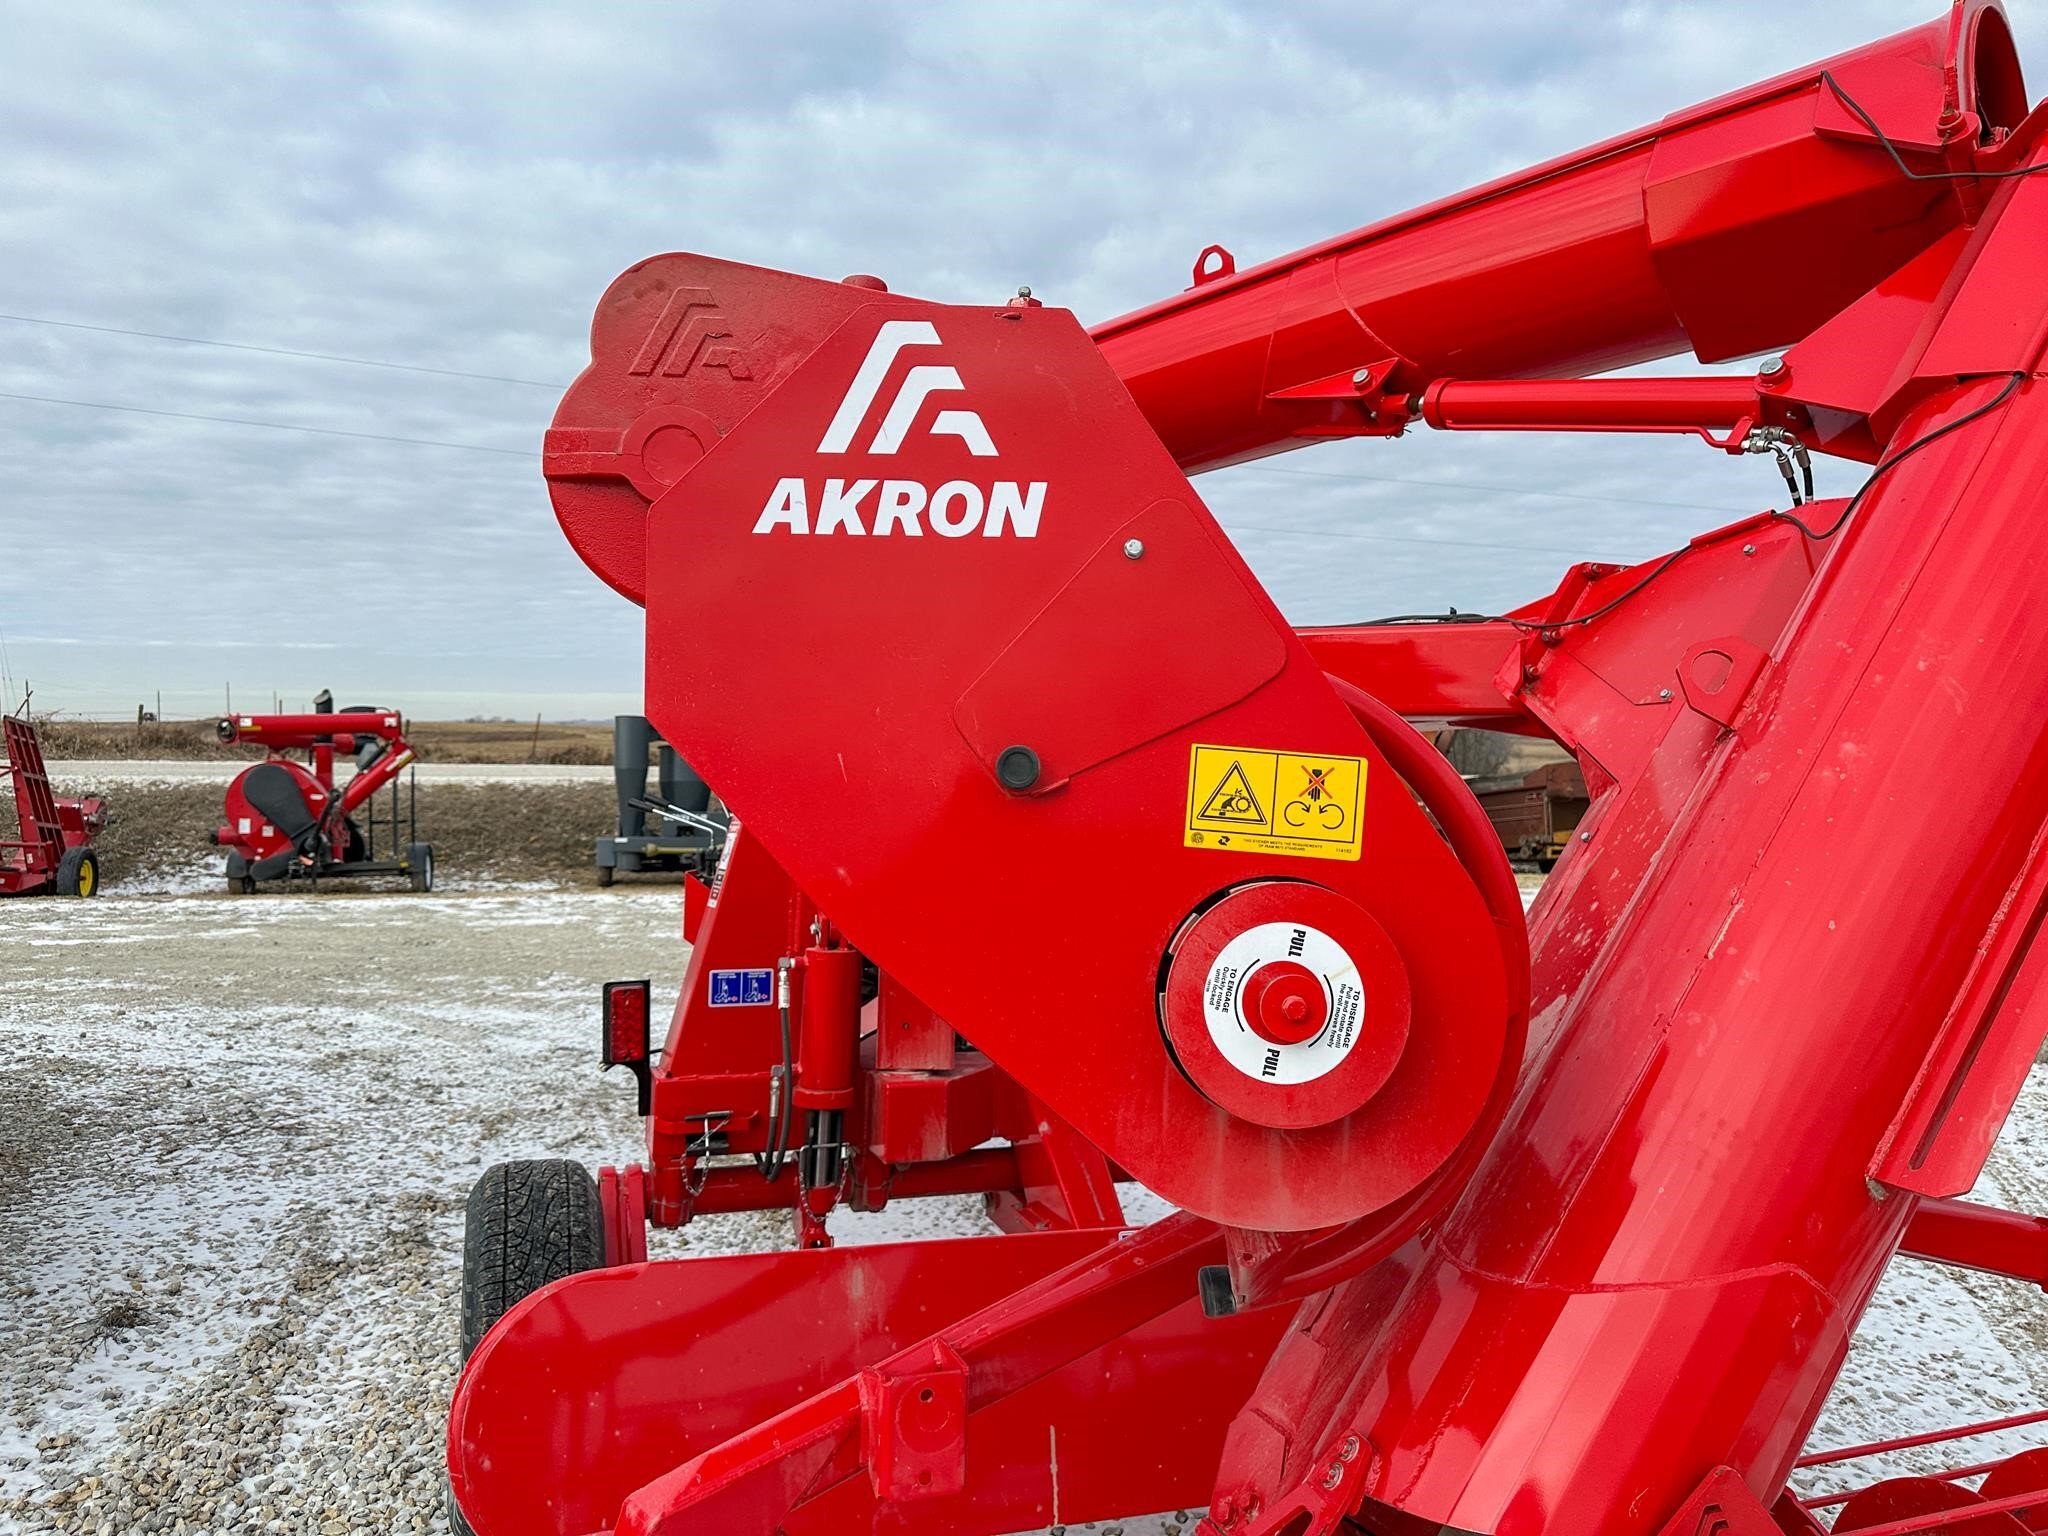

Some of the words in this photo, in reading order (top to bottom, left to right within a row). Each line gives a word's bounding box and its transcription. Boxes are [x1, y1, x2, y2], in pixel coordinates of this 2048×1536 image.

[752, 478, 1048, 538] AKRON
[1288, 928, 1306, 958] PULL
[1218, 966, 1229, 991] Quickly
[1229, 968, 1238, 979] TO
[1209, 984, 1218, 1006] locked
[1222, 980, 1235, 1013] ENGAGE
[1339, 983, 1347, 994] the
[1346, 986, 1354, 1000] Pull
[1352, 990, 1361, 1001] TO
[1214, 991, 1223, 1011] rotate
[1332, 1007, 1341, 1029] moves
[1338, 1013, 1346, 1033] rotate
[1342, 1002, 1358, 1049] DISENGAGE
[1326, 1029, 1337, 1049] freely
[1262, 1047, 1280, 1077] PULL
